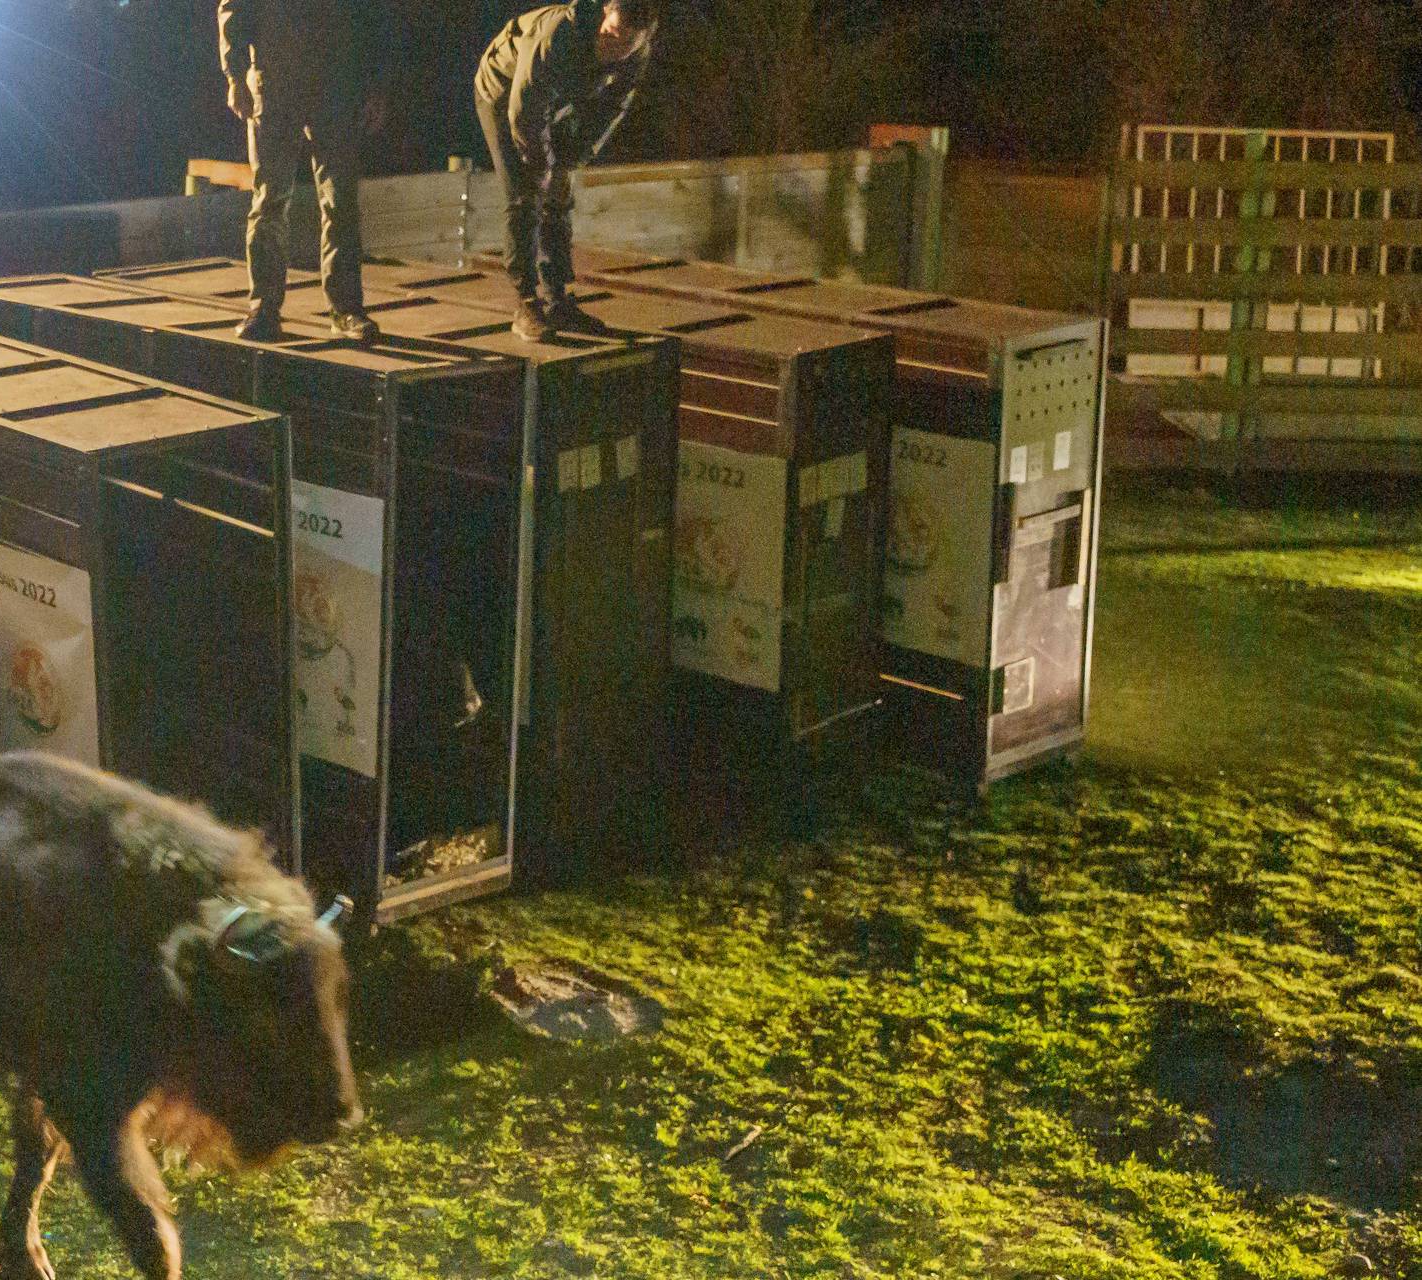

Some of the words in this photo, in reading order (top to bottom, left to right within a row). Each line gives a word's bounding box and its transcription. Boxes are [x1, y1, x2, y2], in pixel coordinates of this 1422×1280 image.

[898, 439, 947, 468] 2022
[696, 460, 745, 489] 2022
[298, 510, 343, 539] 2022
[19, 577, 57, 608] 2022
